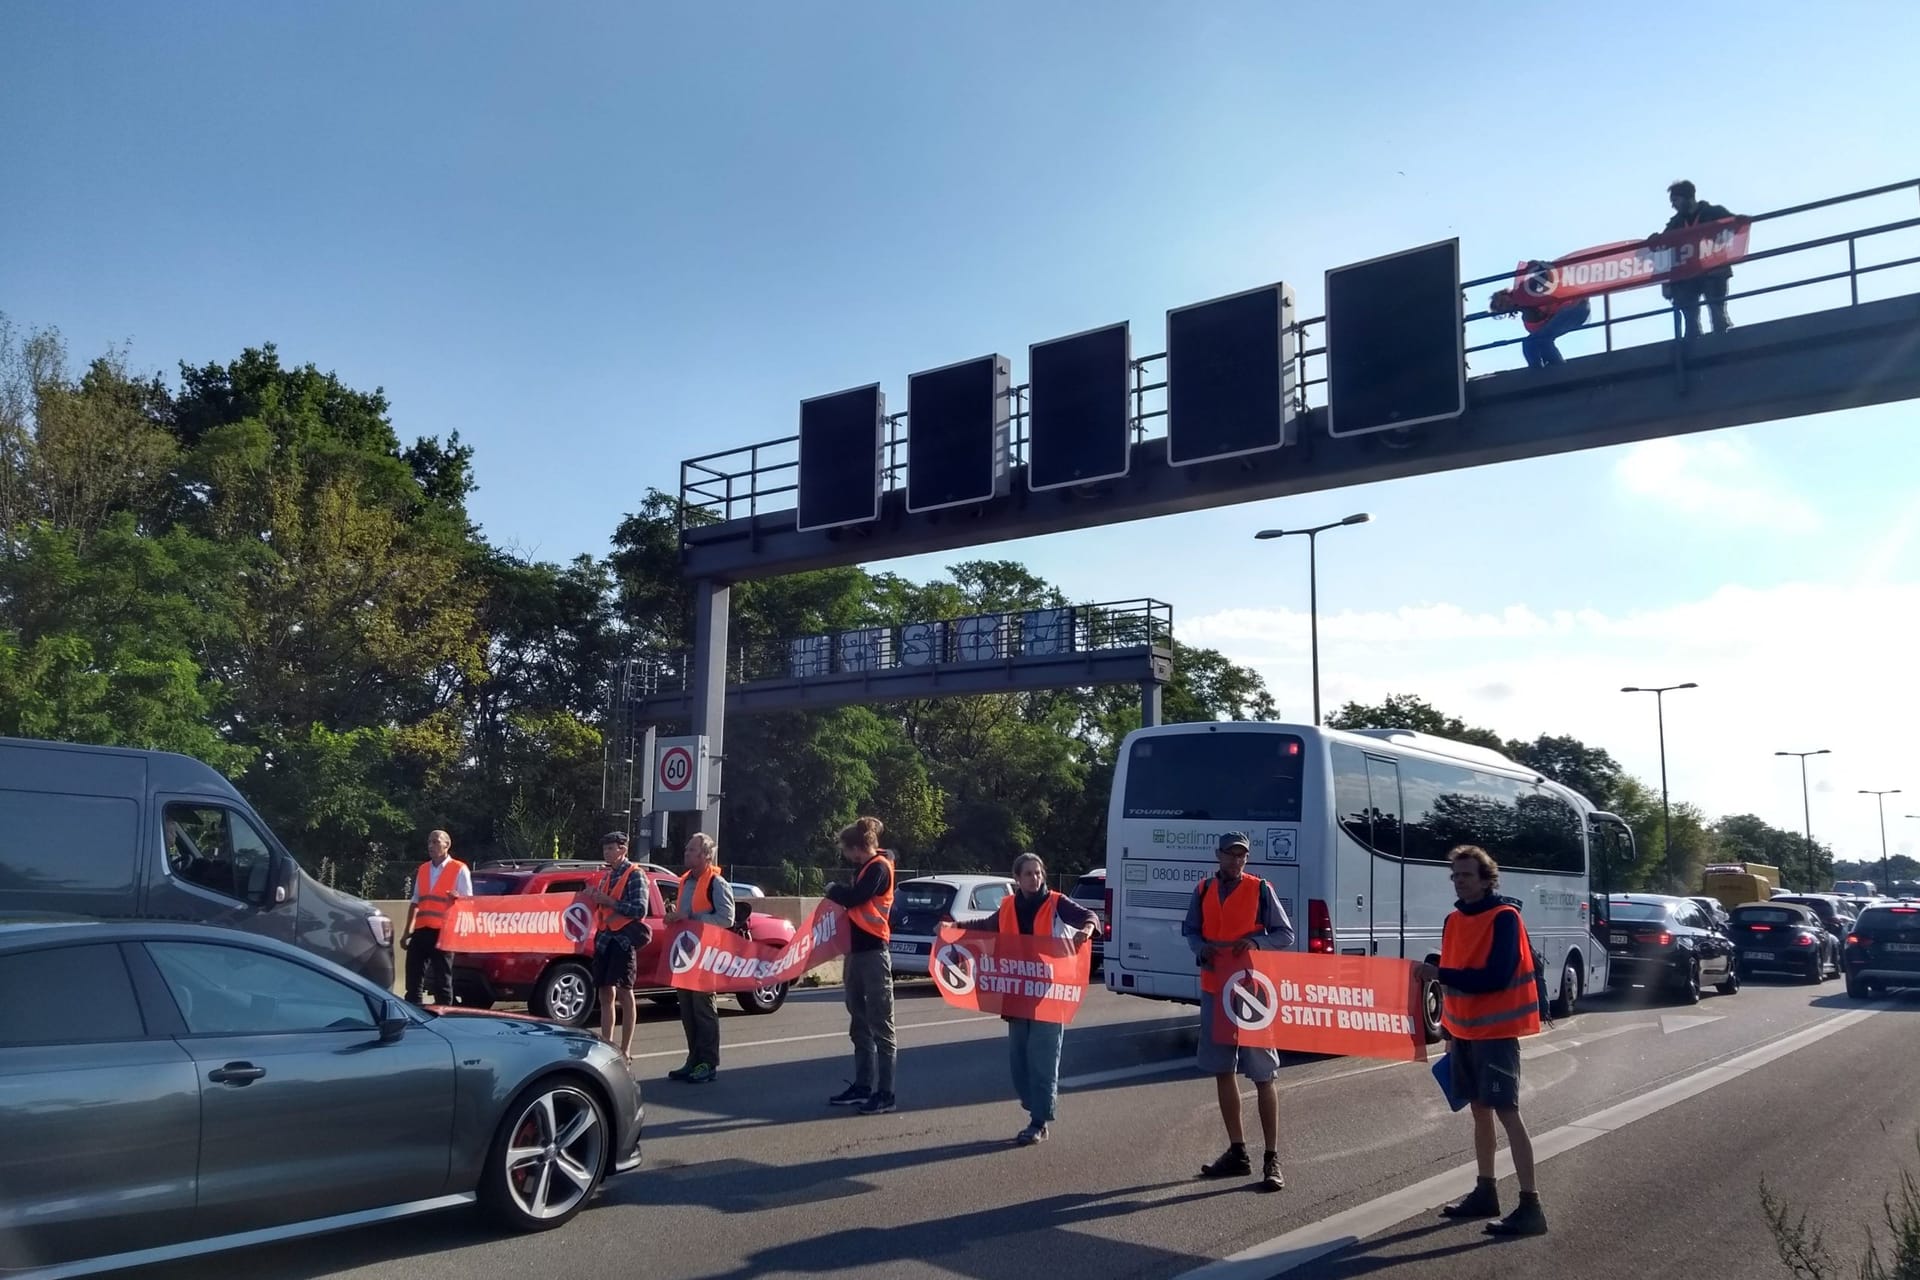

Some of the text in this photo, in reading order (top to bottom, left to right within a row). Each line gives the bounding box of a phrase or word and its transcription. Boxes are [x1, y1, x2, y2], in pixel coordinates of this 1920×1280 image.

[667, 759, 686, 779] 60
[1129, 808, 1184, 816] TOURINO
[1152, 867, 1180, 881] 0800
[980, 954, 1054, 980] ÖL SPAREN
[979, 975, 1082, 1002] STATT BOHREN
[1280, 979, 1375, 1008] ÖL SPAREN
[1281, 1005, 1416, 1035] STATT BOHREN
